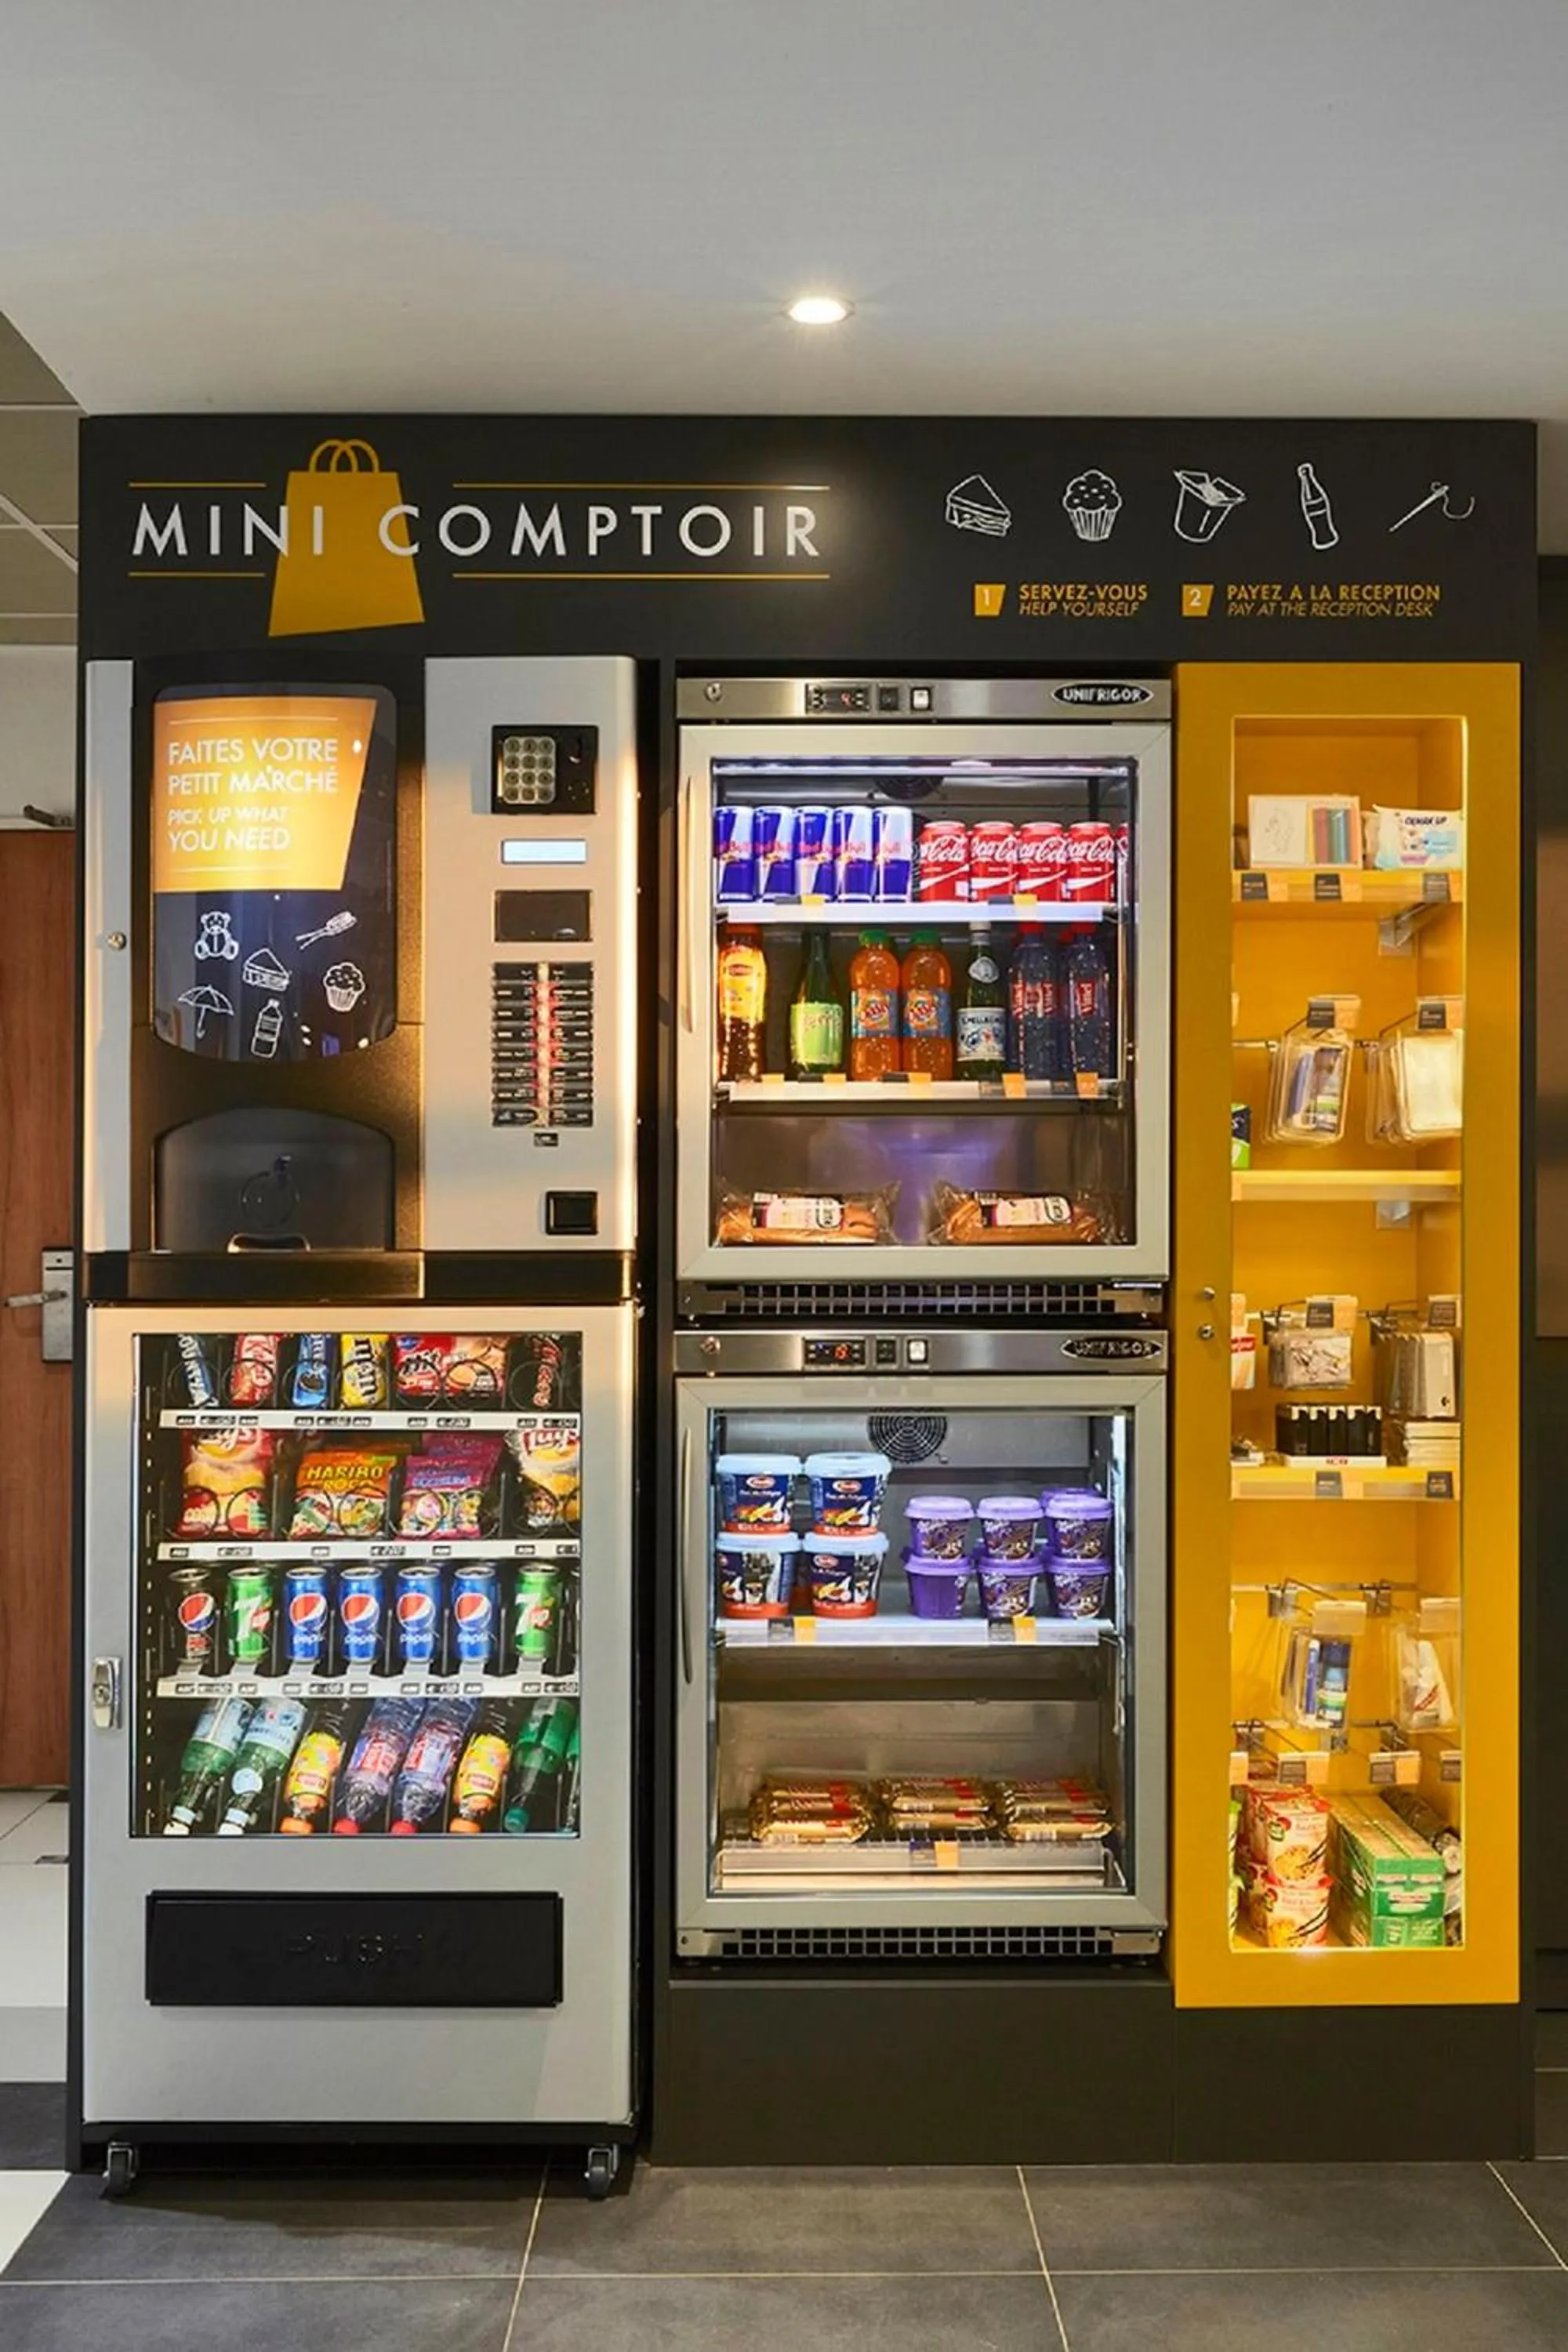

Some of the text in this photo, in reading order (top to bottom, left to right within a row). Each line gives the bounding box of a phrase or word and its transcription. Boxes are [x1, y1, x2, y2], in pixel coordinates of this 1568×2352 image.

[132, 503, 821, 557] MINI COMPTOIR
[983, 588, 990, 608] 1
[1018, 584, 1149, 601] SERVEZ-VOUS
[1189, 588, 1202, 607] 2
[1227, 584, 1441, 601] PAYEZ A LA RECEPTION
[1019, 601, 1140, 617] HELP YOURSELF
[1227, 601, 1434, 617] PAY AT THE RECEPTION DESK
[1062, 688, 1142, 702] UNIFRIGOR
[167, 737, 339, 766] FAITES VOTRE
[167, 772, 223, 796] PETIT
[167, 806, 289, 826] PICK UP WHAT
[168, 827, 291, 852] YOU NEED
[307, 1465, 383, 1480] HARIBO
